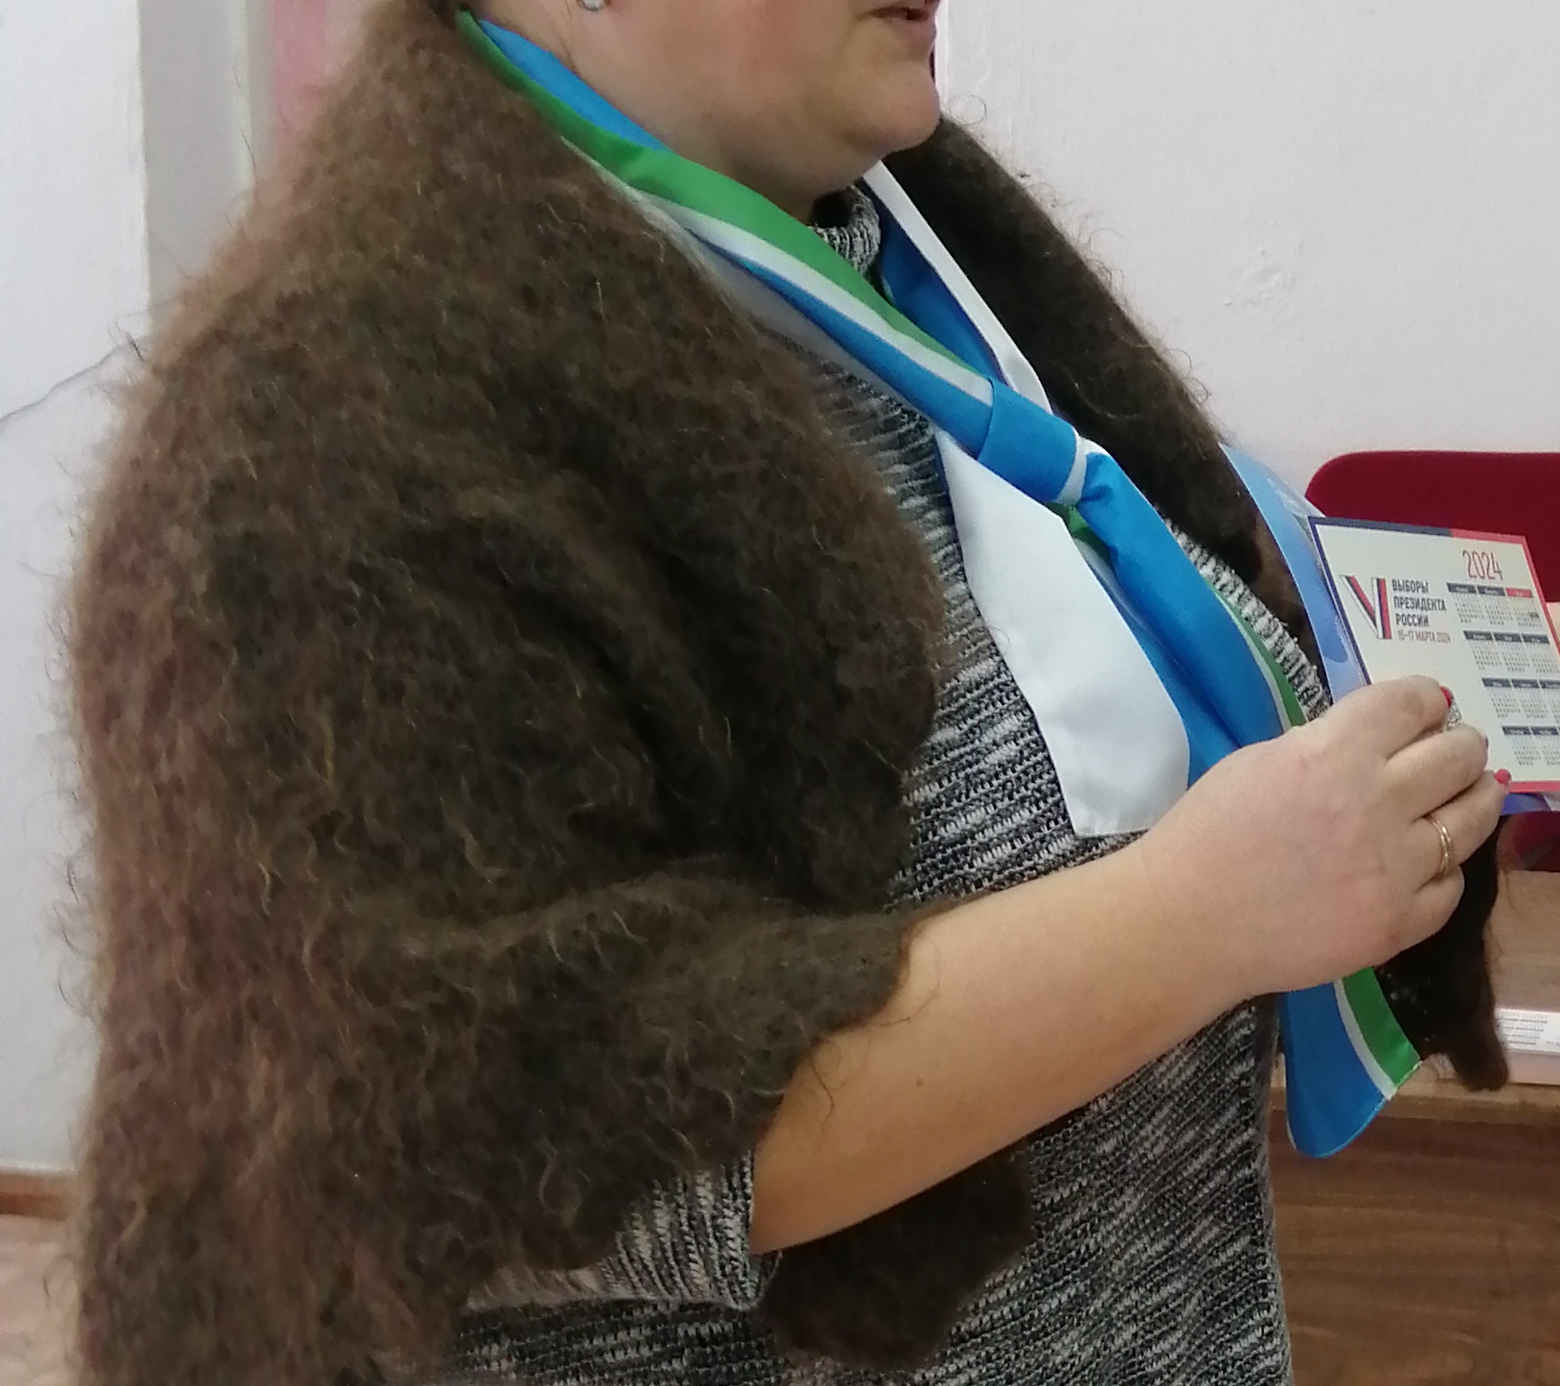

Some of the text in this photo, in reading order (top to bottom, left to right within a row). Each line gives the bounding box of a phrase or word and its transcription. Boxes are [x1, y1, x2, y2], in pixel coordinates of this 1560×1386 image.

[1462, 549, 1503, 580] 2024
[1391, 579, 1429, 592] ВЫБОРЫ
[1393, 597, 1446, 611] ПРЕЗИДЕНТА
[1396, 614, 1429, 626] РОССИИ
